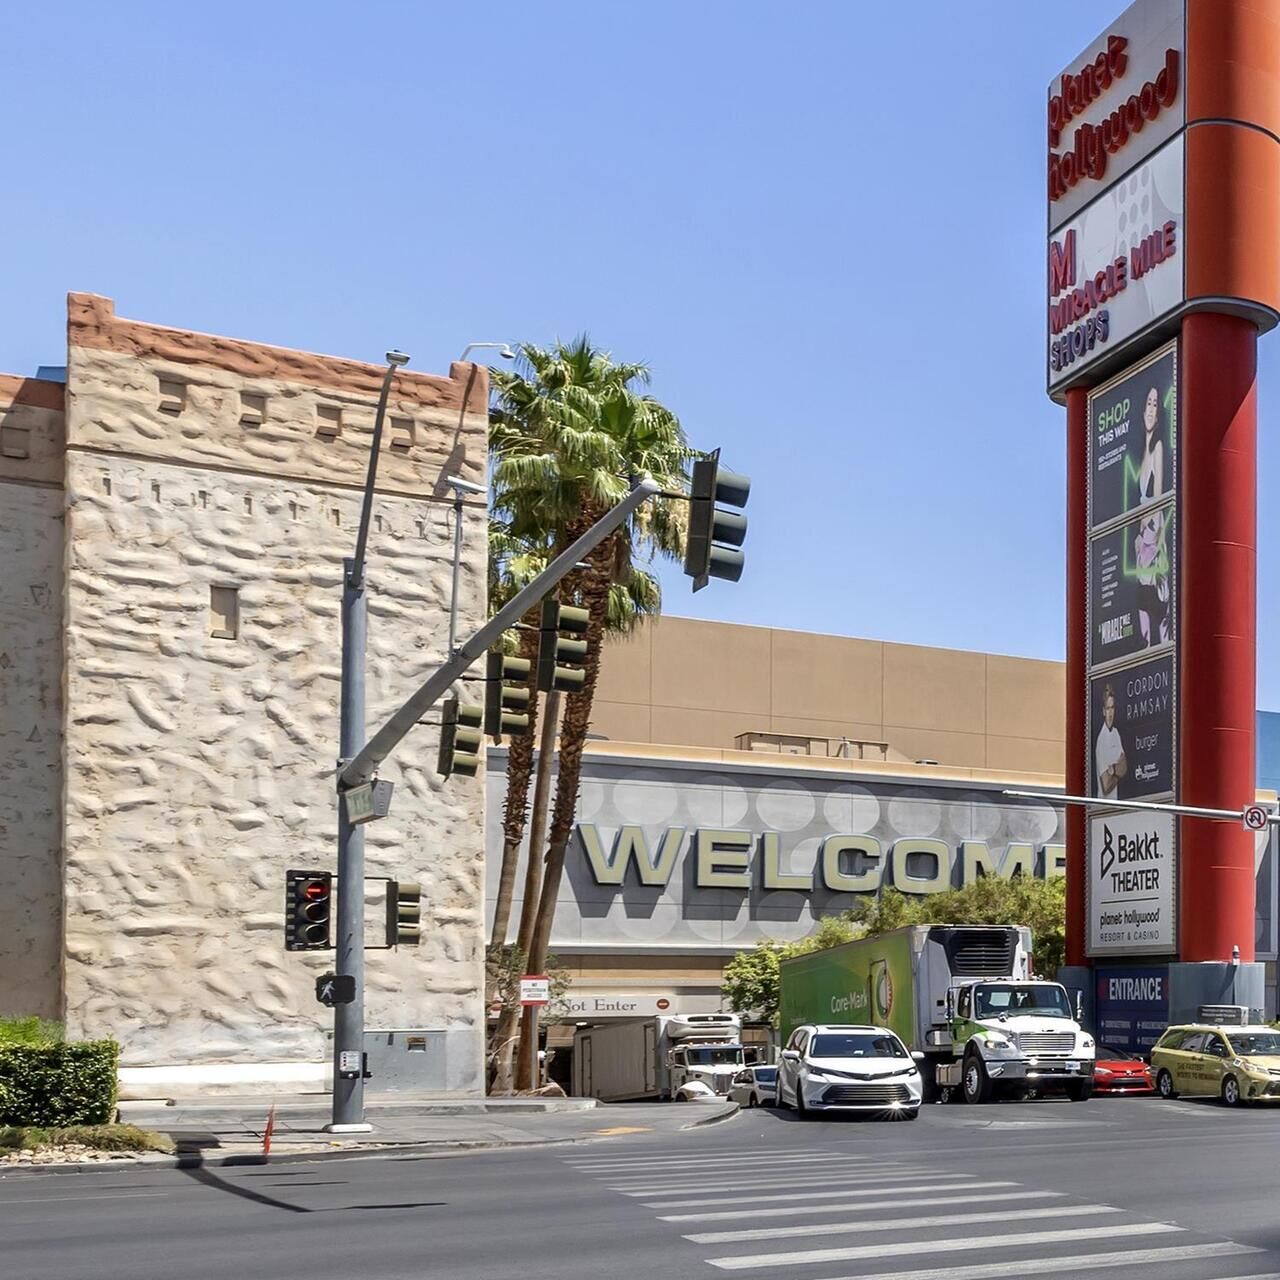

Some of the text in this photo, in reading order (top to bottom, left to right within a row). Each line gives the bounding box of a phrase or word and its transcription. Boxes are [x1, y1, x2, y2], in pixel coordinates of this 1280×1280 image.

[1048, 35, 1128, 148] planet
[1048, 48, 1180, 202] hollywood
[1051, 220, 1177, 335] MIRACLE MILE
[1051, 310, 1110, 372] SHOPS
[1098, 398, 1130, 432] SHOP
[1098, 420, 1130, 447] THIS WAY
[1127, 671, 1168, 697] GORDON
[1127, 695, 1168, 720] RAMSAY
[1136, 734, 1159, 751] burger
[1118, 830, 1159, 863] Bakkt
[1111, 868, 1159, 893] THEATER
[1100, 908, 1160, 929] planet hollywood
[1101, 931, 1125, 942] RESORT
[1133, 930, 1159, 941] CASINO
[1109, 977, 1162, 1001] ENTRANCE
[560, 999, 586, 1011] Not
[595, 999, 637, 1011] Enter
